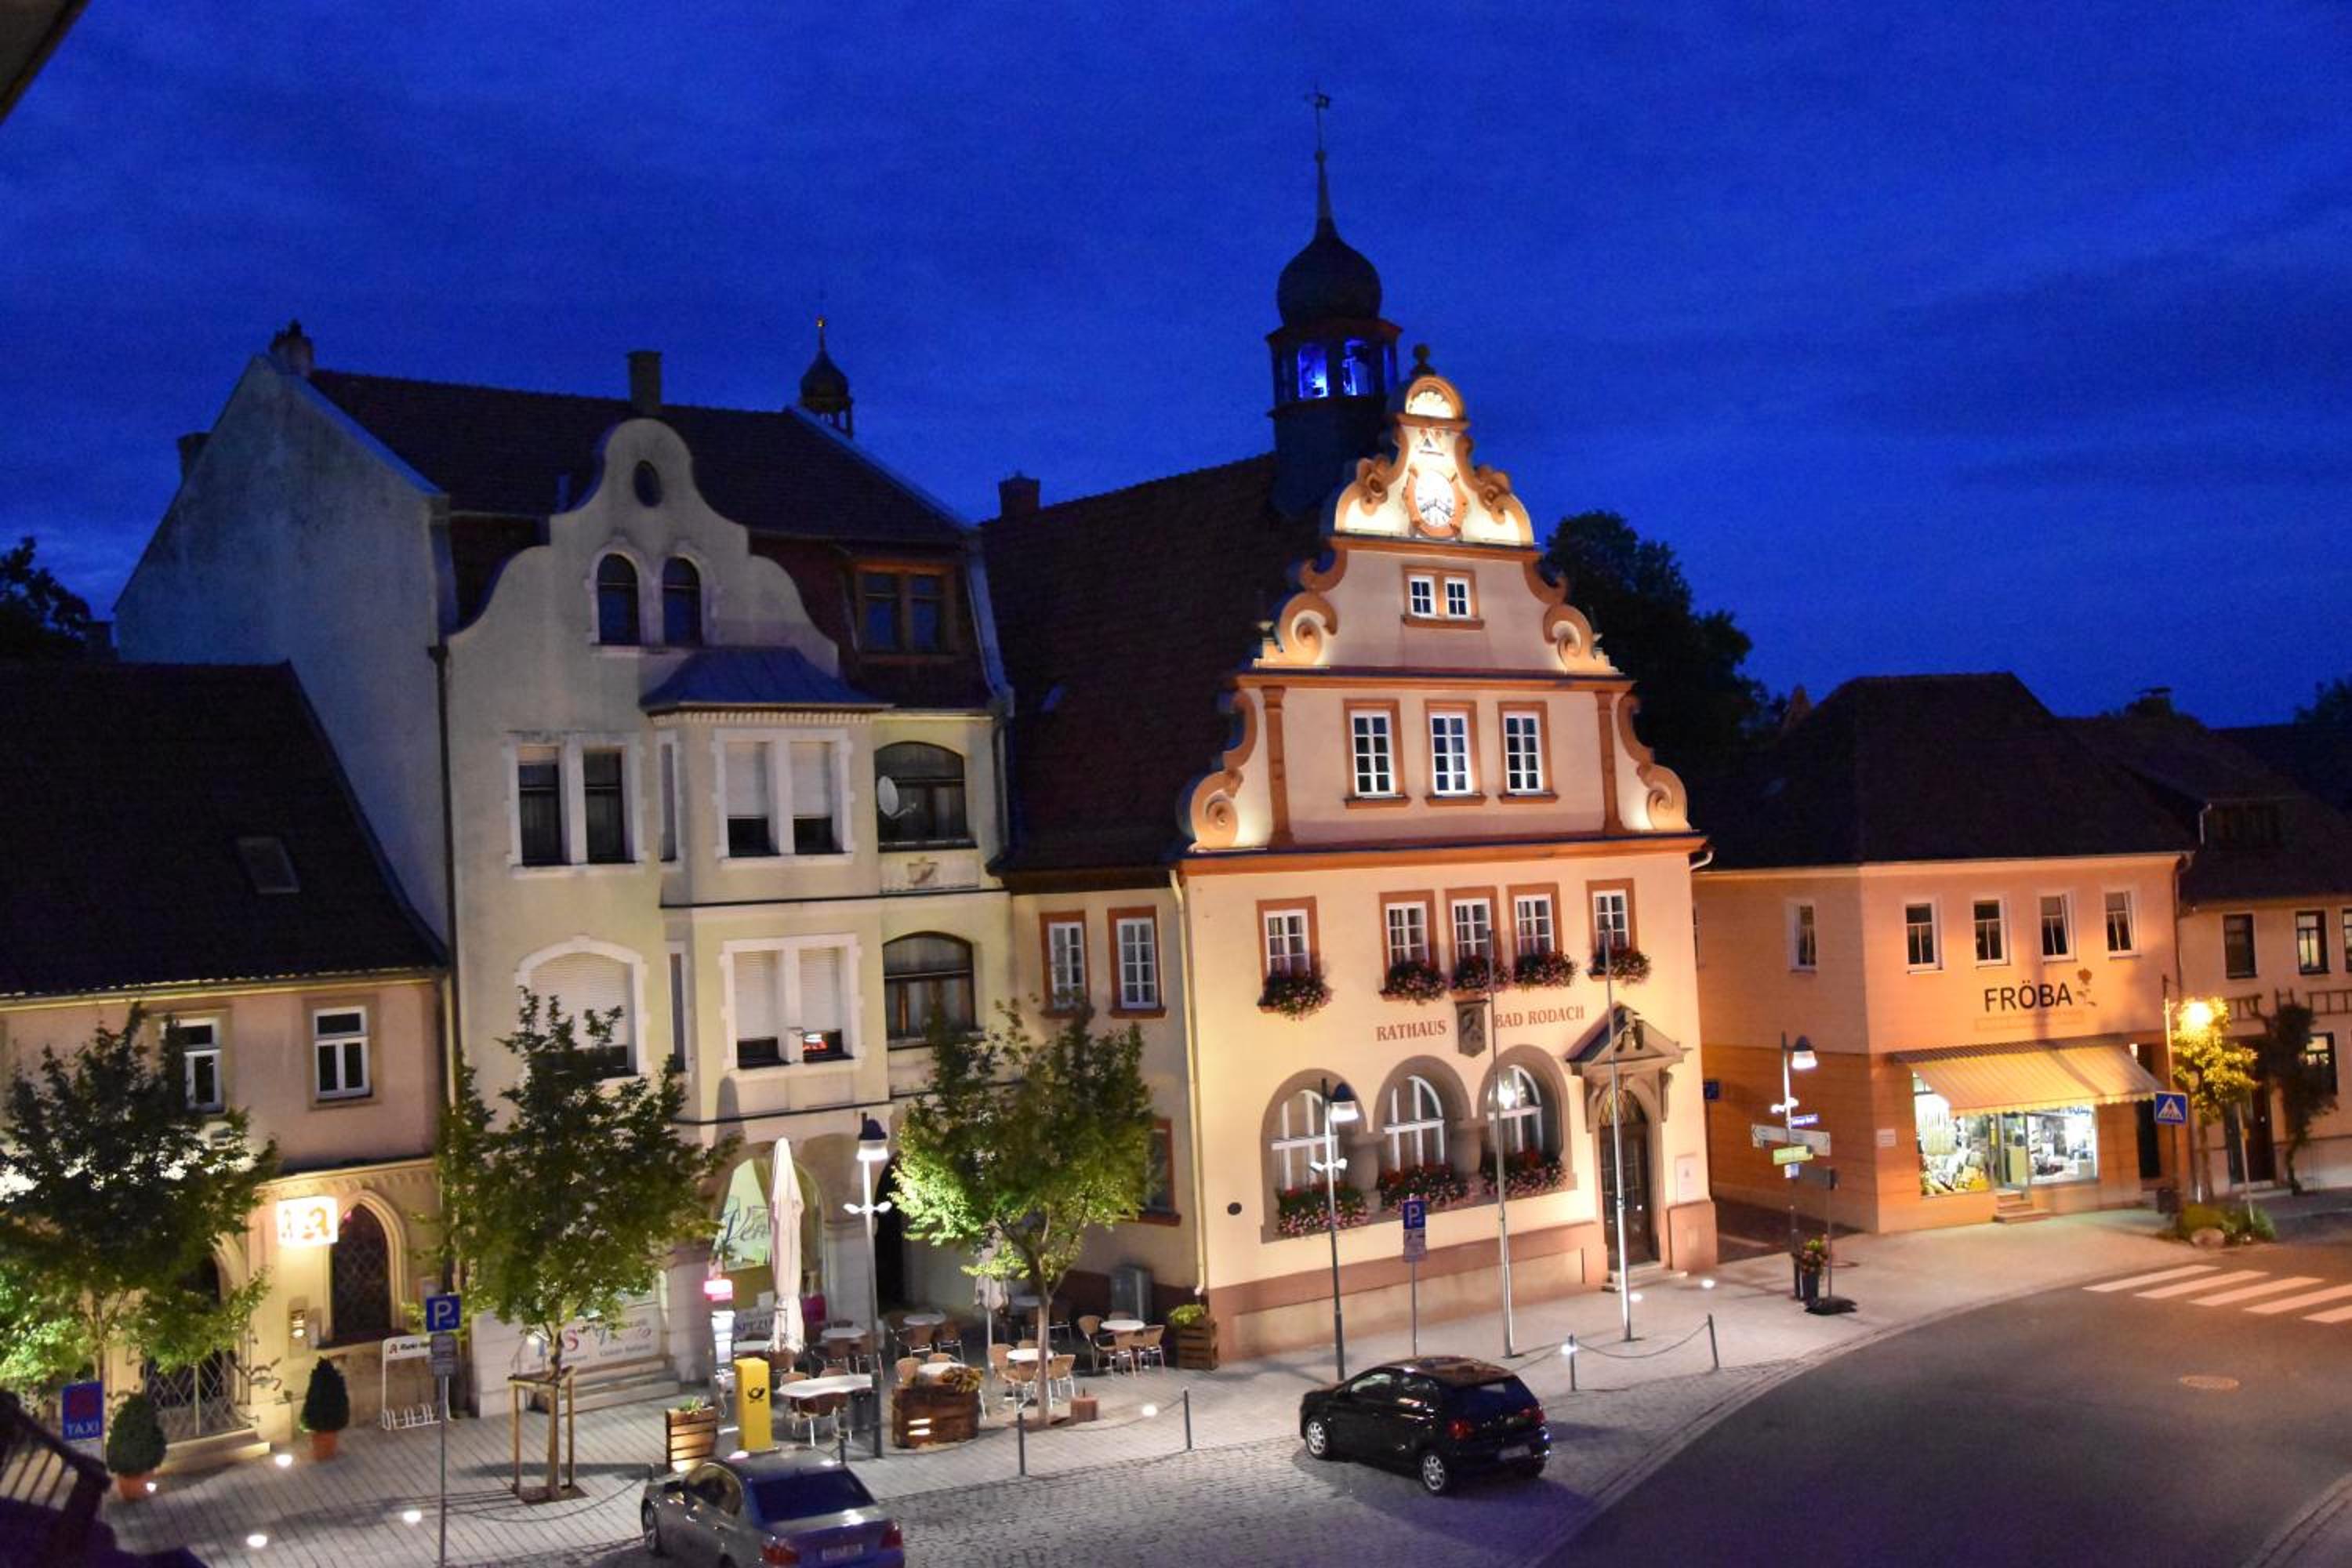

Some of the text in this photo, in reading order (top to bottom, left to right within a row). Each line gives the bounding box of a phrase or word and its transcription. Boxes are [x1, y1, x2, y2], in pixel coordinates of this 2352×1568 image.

[1984, 980, 2073, 1012] FRÖBA
[1376, 1005, 1584, 1041] RATHAUS BAD RODACH
[1408, 1204, 1420, 1225] P
[435, 1301, 452, 1328] P
[66, 1420, 100, 1437] TAXI
